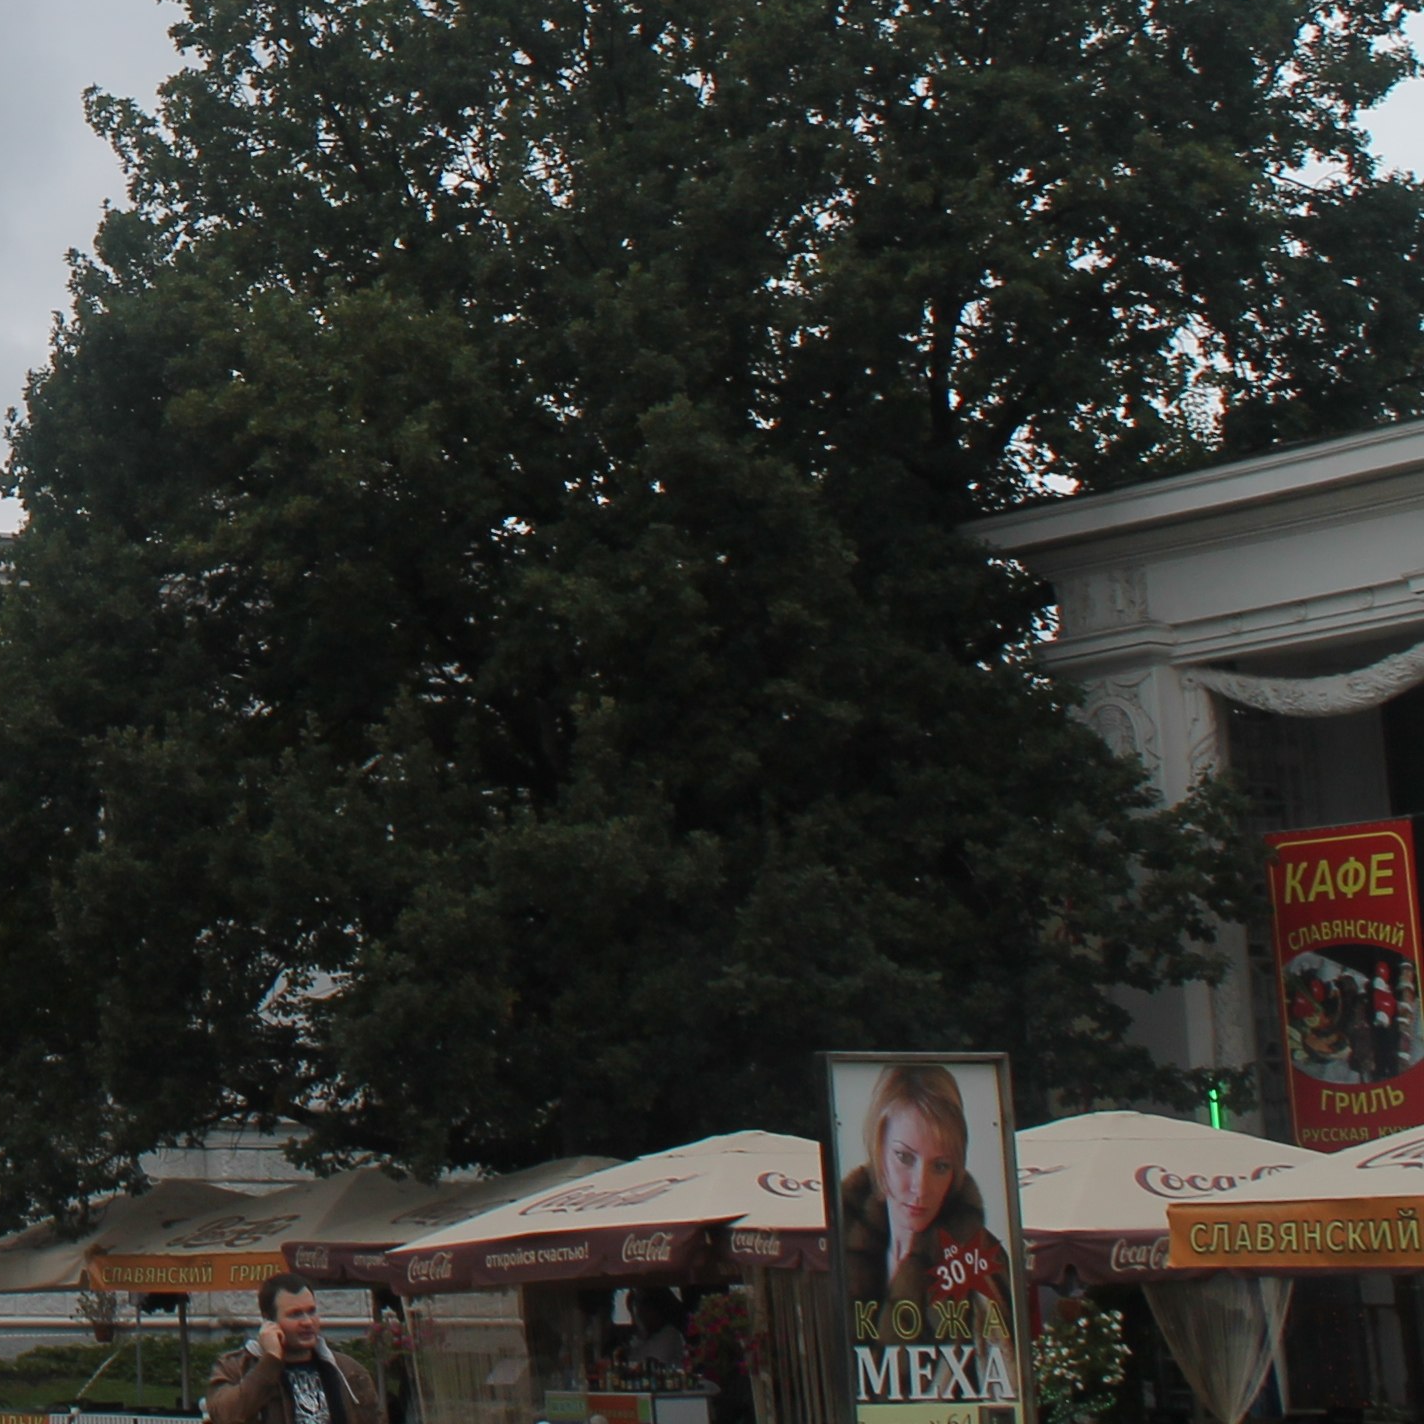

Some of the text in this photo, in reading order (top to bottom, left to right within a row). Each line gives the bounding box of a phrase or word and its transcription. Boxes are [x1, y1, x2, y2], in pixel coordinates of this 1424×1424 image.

[1284, 852, 1395, 905] КАФЕ
[1288, 920, 1405, 951] СЛАВЯНСКИЙ
[1321, 1085, 1405, 1115] ГРИЛЬ
[1302, 1127, 1369, 1143] РУССКАЯ
[1190, 1208, 1419, 1253] СЛАВЯНСКИЙ
[485, 1241, 589, 1271] откройся счастью!
[101, 1262, 214, 1285] СЛАВЯНСКИЙ
[854, 1300, 1010, 1340] КОЖА
[854, 1345, 1016, 1401] МЕХА
